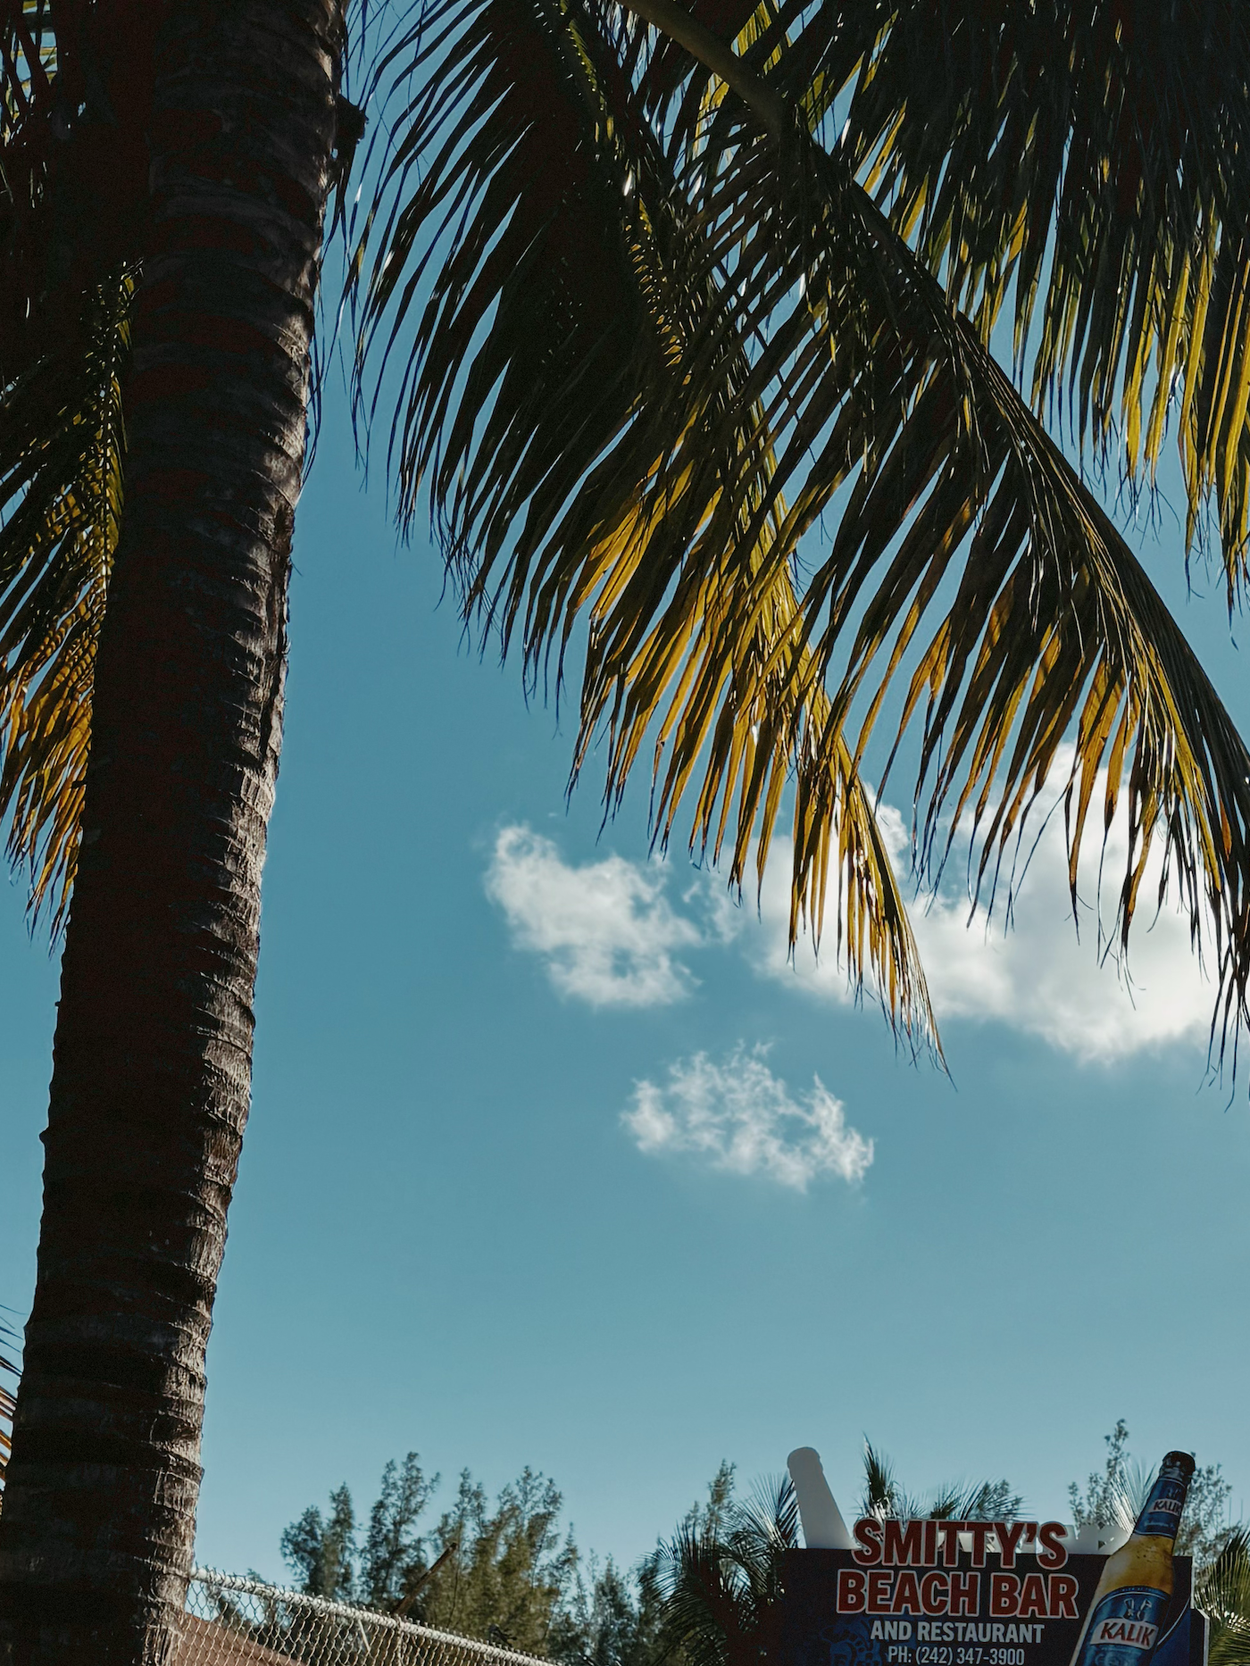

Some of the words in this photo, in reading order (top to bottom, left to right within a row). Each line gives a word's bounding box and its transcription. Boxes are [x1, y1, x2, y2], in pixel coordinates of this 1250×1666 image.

[851, 1518, 1069, 1569] SMITTY'S
[836, 1569, 980, 1616] BEACH
[989, 1572, 1079, 1619] BAR
[870, 1620, 912, 1640] AND
[917, 1621, 1045, 1644] RESTAURANT
[1100, 1622, 1155, 1647] KALIK
[887, 1646, 912, 1663] PH:
[915, 1646, 953, 1666] (242)
[956, 1648, 1025, 1666] 347-3900
